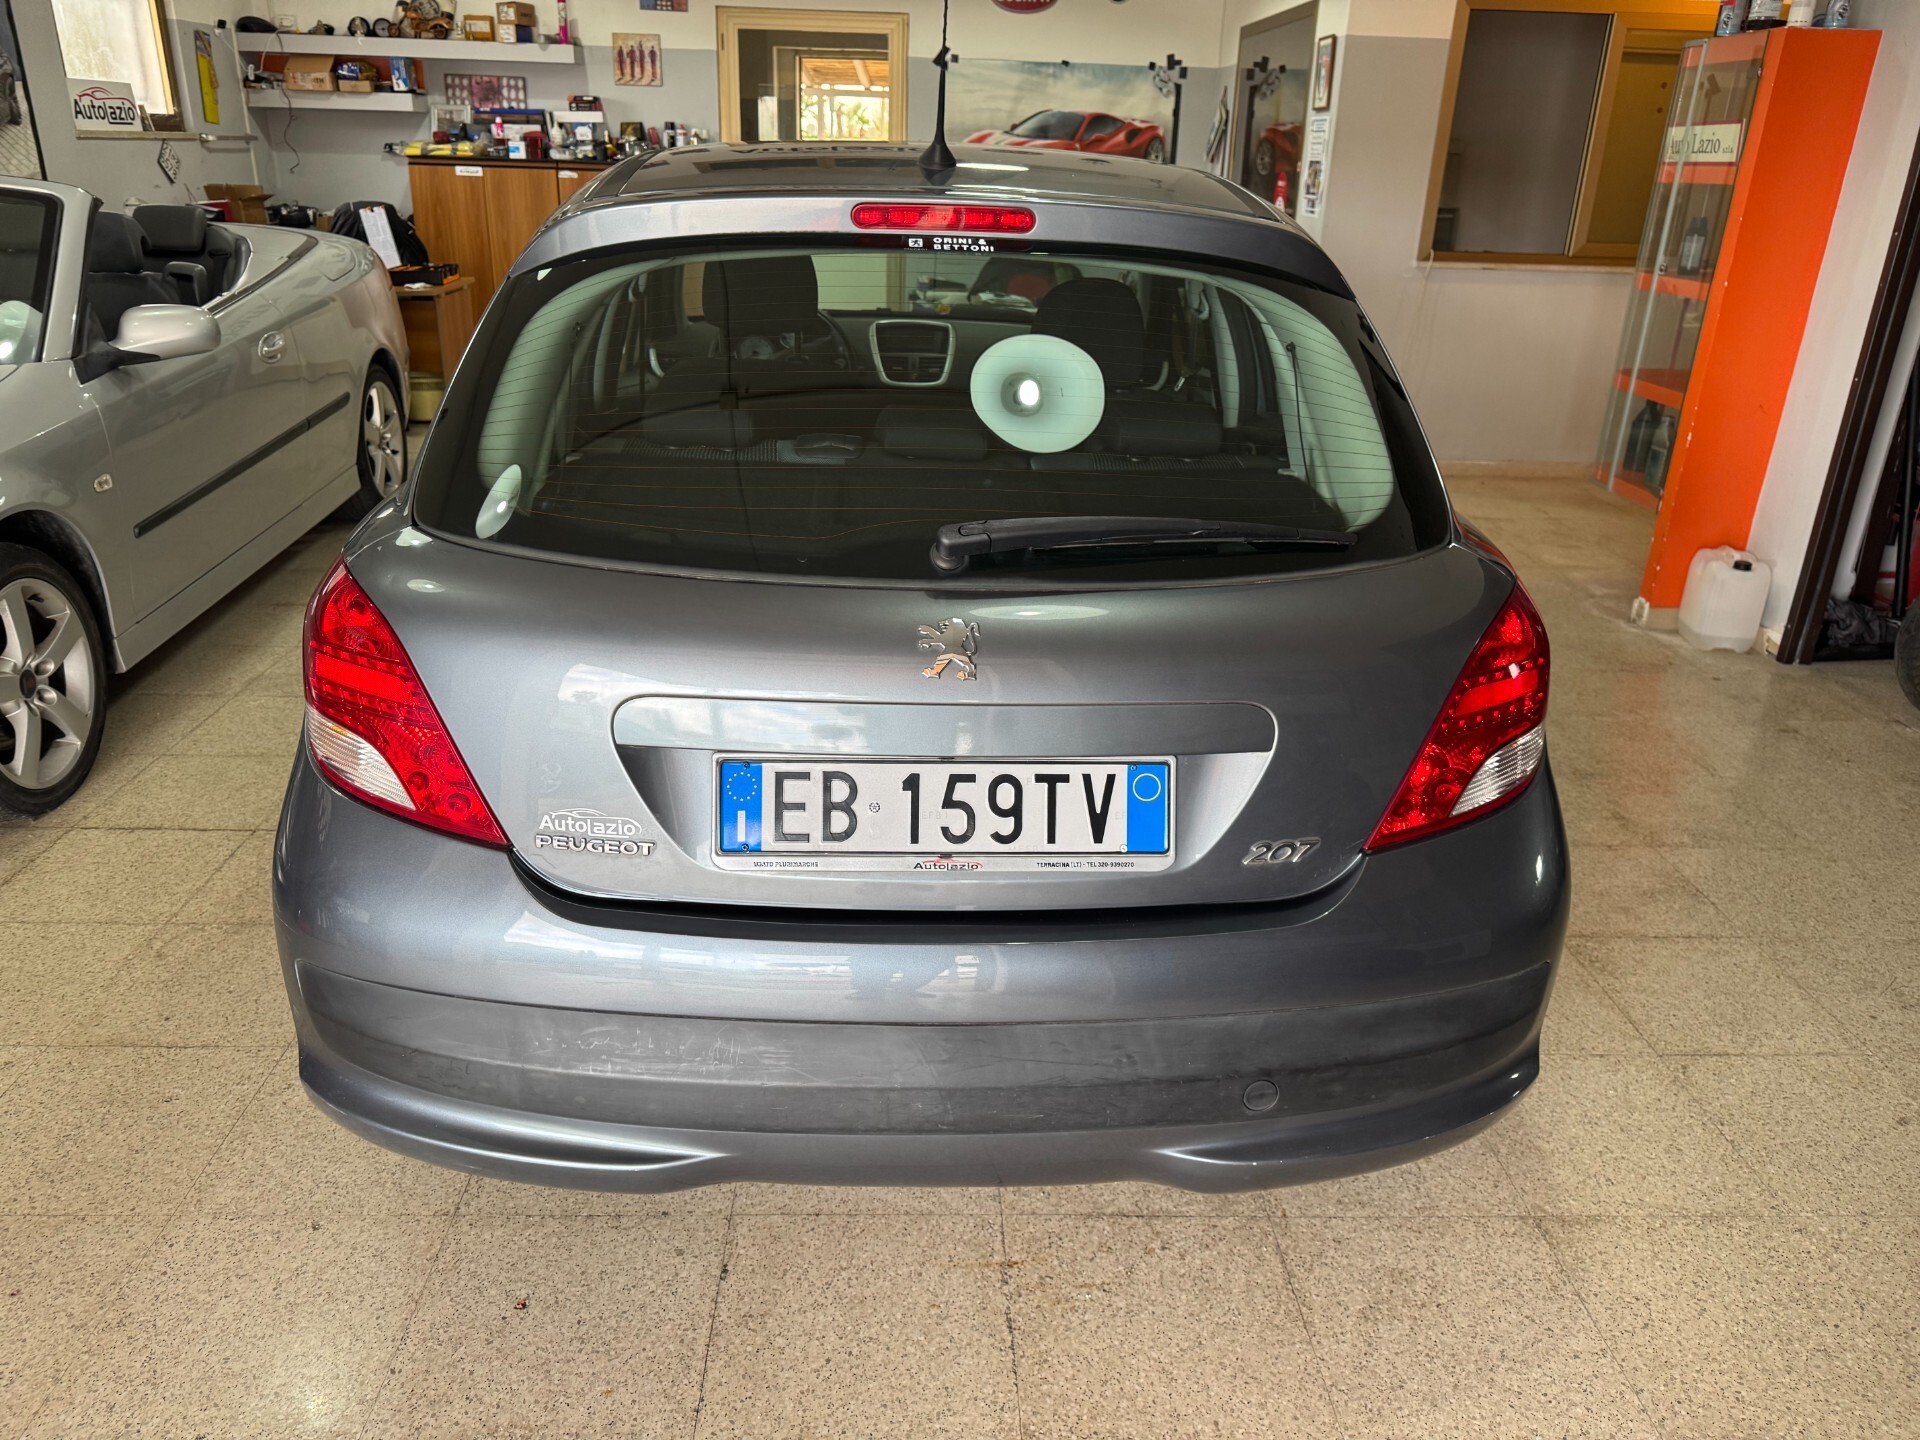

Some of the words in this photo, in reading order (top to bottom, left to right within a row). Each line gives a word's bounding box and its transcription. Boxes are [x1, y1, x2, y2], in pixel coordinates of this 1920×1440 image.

[1691, 132, 1721, 154] Lazio
[933, 237, 972, 245] ORINI
[933, 243, 995, 252] BETTONI
[774, 771, 858, 843] EB
[901, 773, 1116, 845] 159TV
[534, 833, 656, 856] PEUGEOT
[1241, 837, 1321, 865] 207
